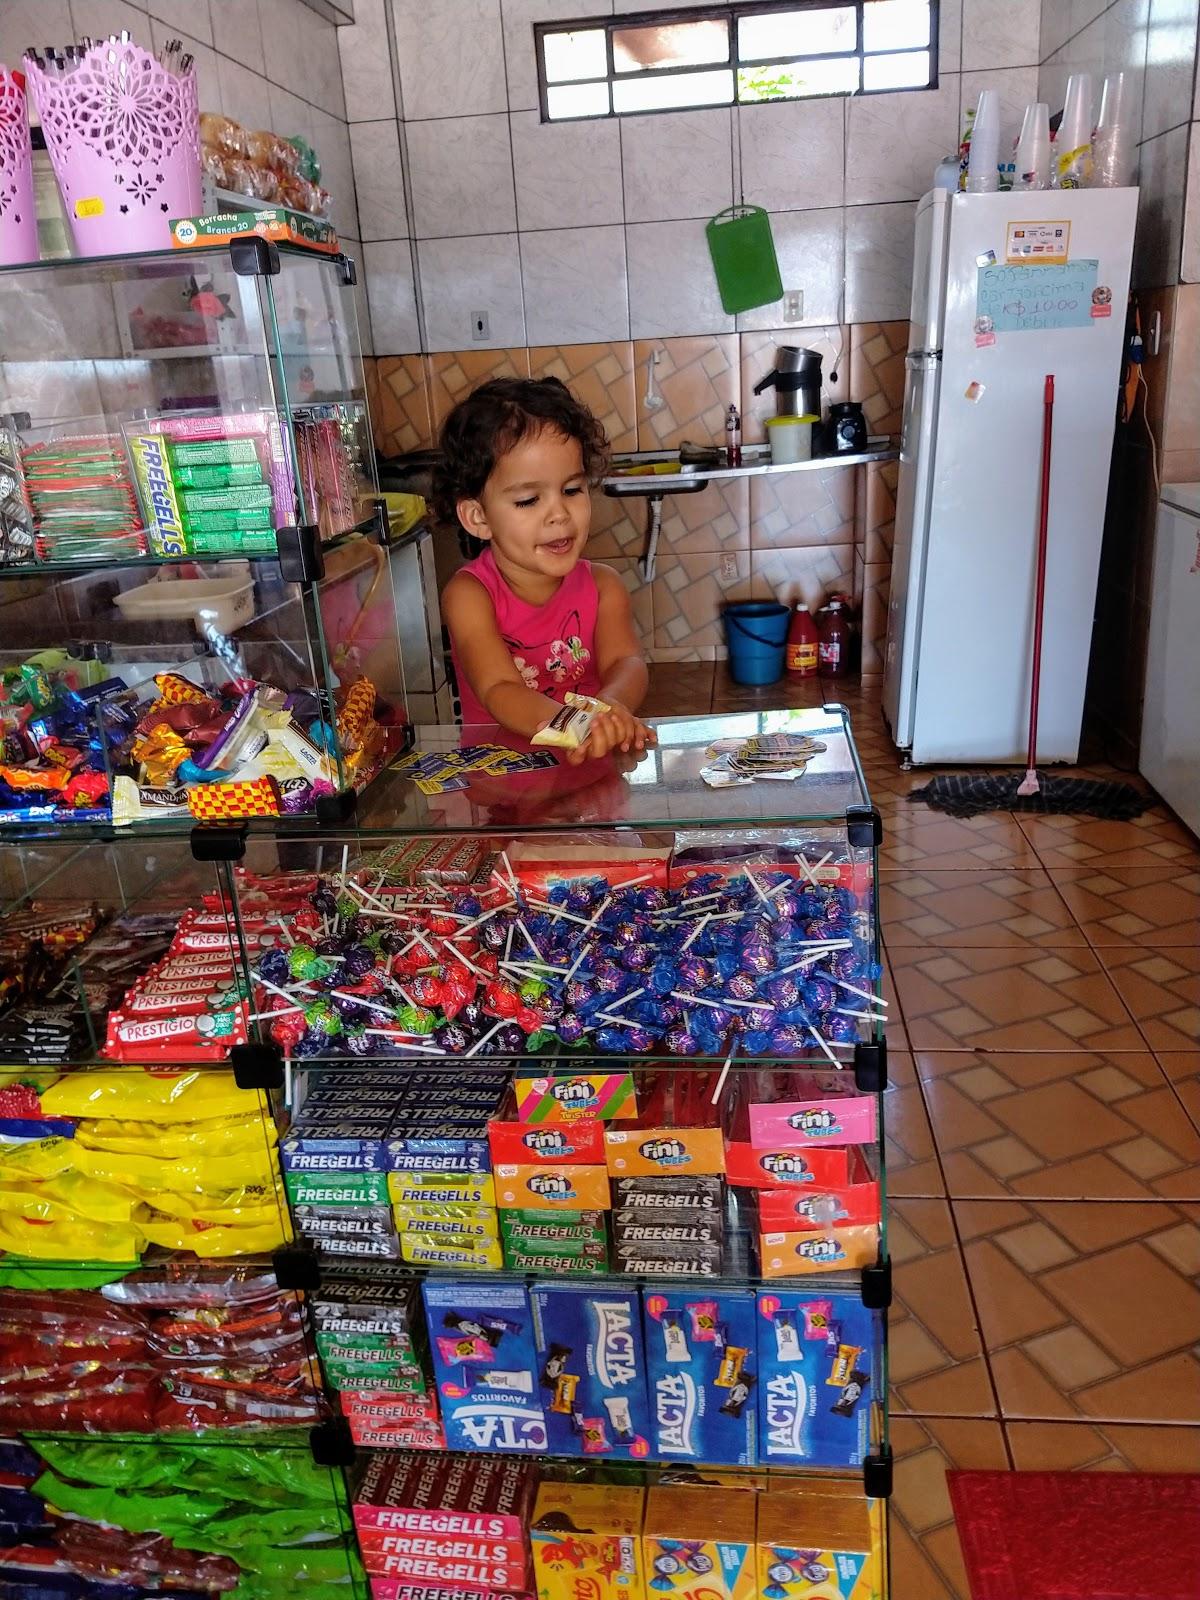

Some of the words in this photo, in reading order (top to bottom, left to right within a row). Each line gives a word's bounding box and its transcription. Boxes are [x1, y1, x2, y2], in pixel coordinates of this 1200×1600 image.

[199, 213, 237, 226] Borracha
[180, 228, 192, 236] 20
[206, 224, 237, 234] Branca
[238, 222, 248, 231] 20
[140, 438, 183, 555] FREEGELLS
[149, 978, 216, 993] PRESTIGIO
[137, 993, 206, 1009] PRESTIGIO
[127, 1018, 195, 1040] PRESTIGIO
[553, 1080, 595, 1100] Fini
[791, 1110, 832, 1129] Fini
[525, 1130, 563, 1148] Fini
[642, 1140, 680, 1157] Fini
[290, 1155, 375, 1169] FREEGELLS
[394, 1155, 480, 1170] FREEGELLS
[763, 1155, 802, 1174] Fini
[530, 1176, 566, 1193] Fini
[296, 1188, 379, 1202] FREEGELLS
[402, 1190, 482, 1202] FREEGELLS
[625, 1193, 713, 1208] FREEGELLS
[301, 1218, 384, 1234] FREEGELLS
[407, 1219, 485, 1235] FREEGELLS
[510, 1224, 593, 1239] FREEGELLS
[622, 1226, 711, 1241] FREEGELLS
[312, 1238, 391, 1255] FREEGELLS
[799, 1237, 836, 1256] Fini
[411, 1249, 488, 1265] FREEGELLS
[515, 1256, 597, 1271] FREEGELLS
[624, 1260, 712, 1274] FREEGELLS
[320, 1283, 409, 1300] FREEGELLS
[322, 1319, 401, 1334] FREEGELLS
[595, 1301, 638, 1387] LACTA
[330, 1347, 404, 1362] FREEGELLS
[340, 1377, 413, 1390] FREEGELLS
[471, 1394, 528, 1406] FAVORITOS
[352, 1404, 425, 1418] FREEGELLS
[655, 1373, 695, 1456] LACTA
[766, 1373, 805, 1456] LACTA
[361, 1431, 434, 1445] FREEGELLS
[376, 1511, 504, 1537] FREEGELLS
[382, 1536, 508, 1562] FREEGELLS
[383, 1556, 508, 1584] FREEGELLS
